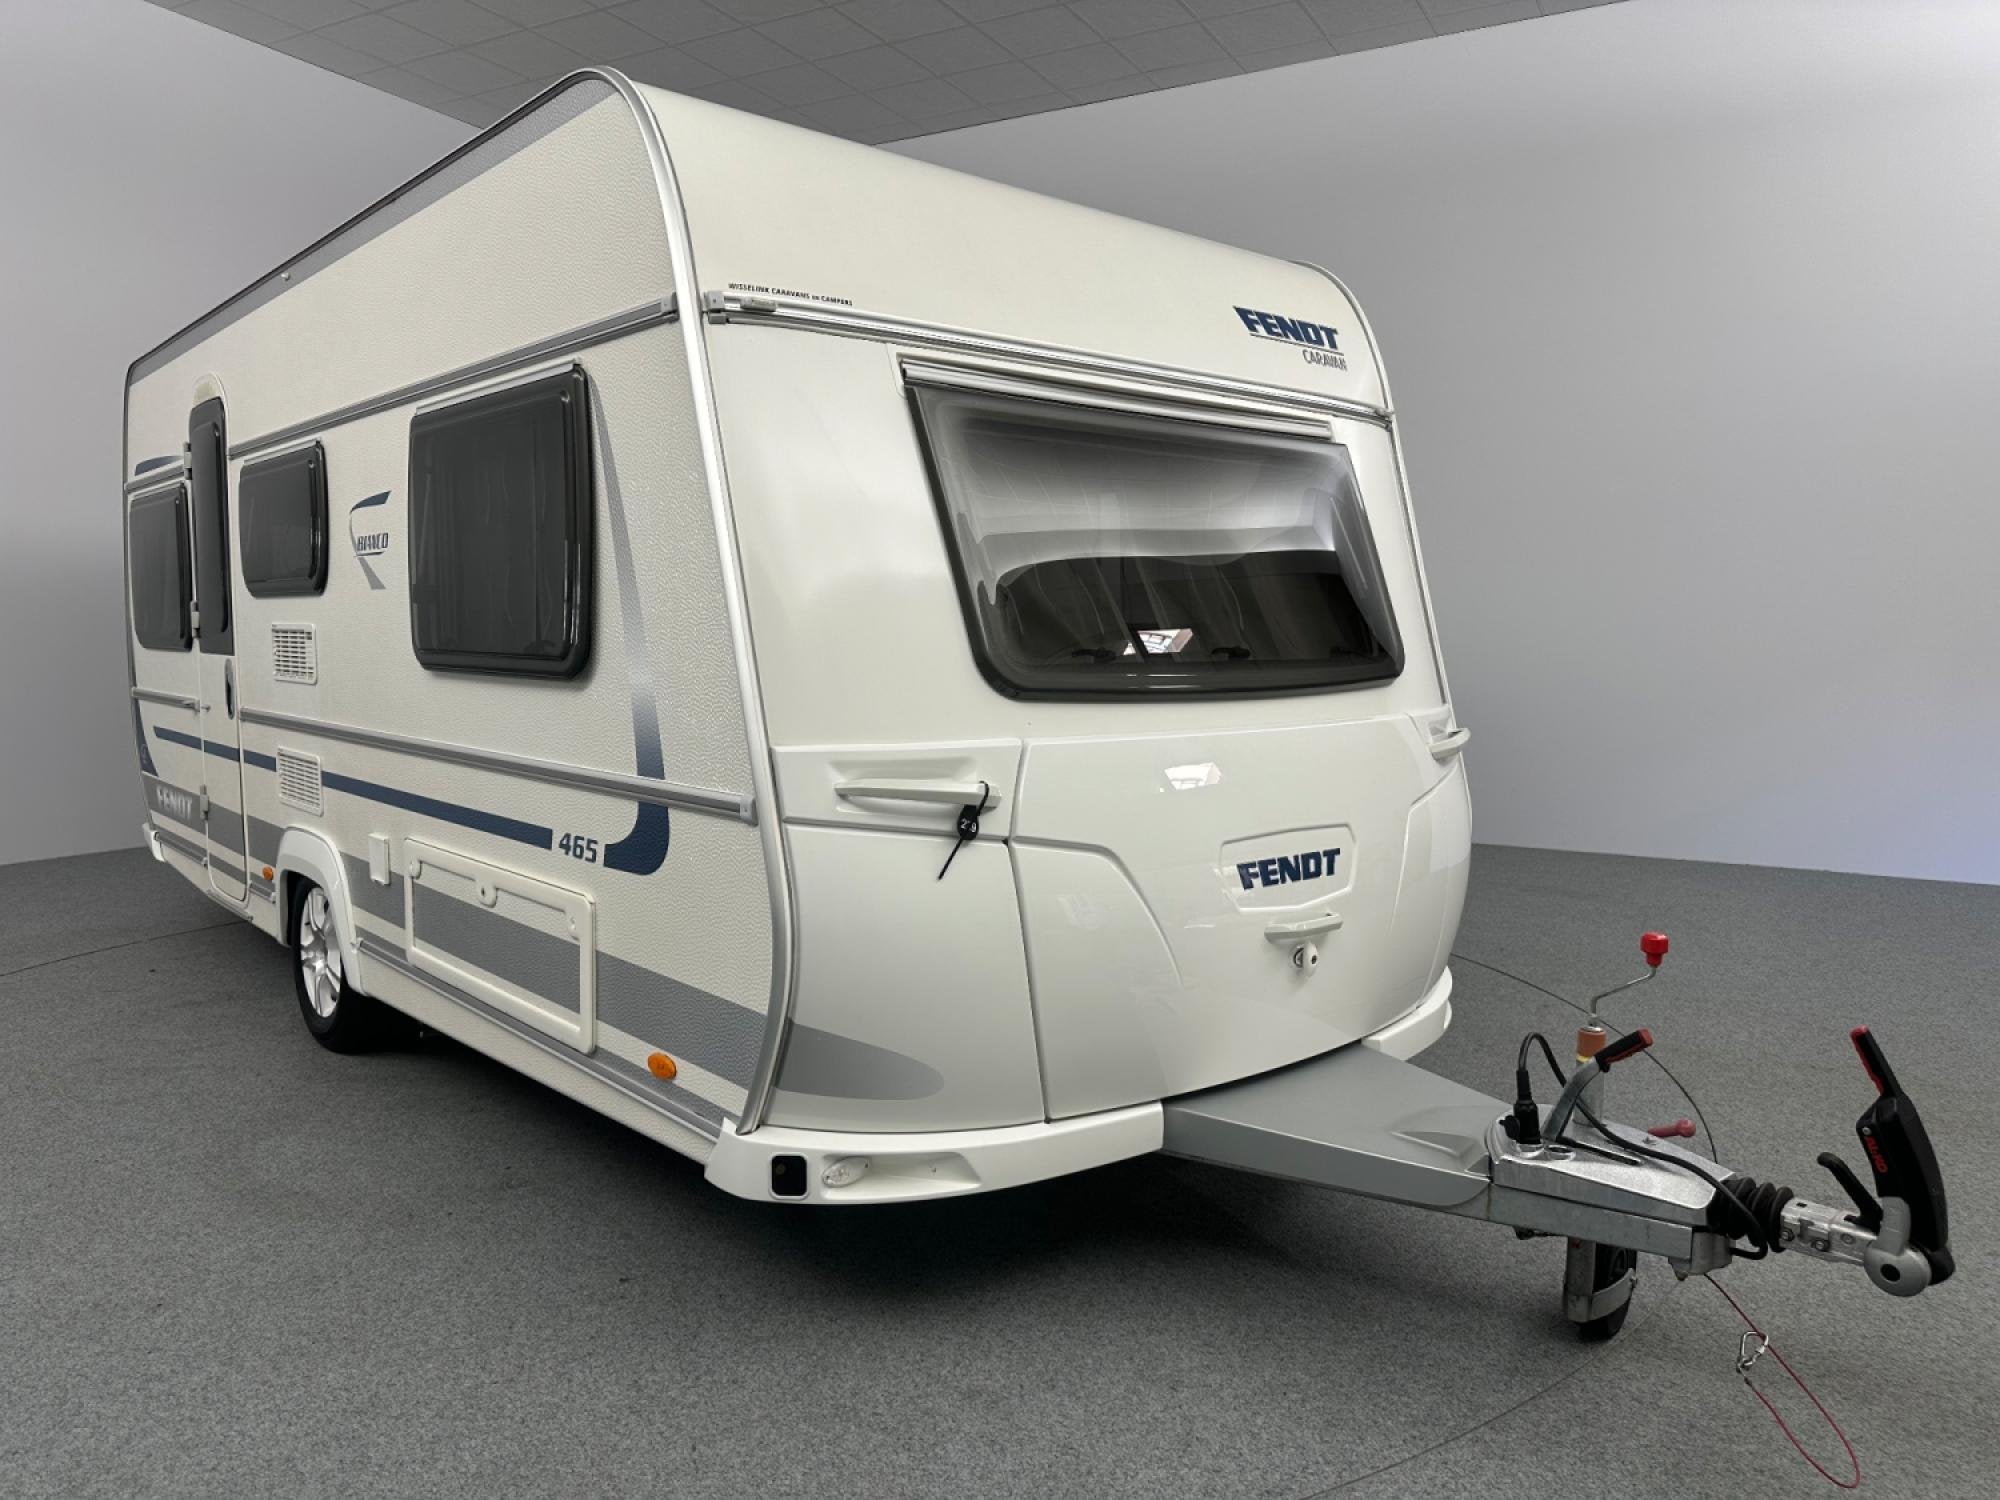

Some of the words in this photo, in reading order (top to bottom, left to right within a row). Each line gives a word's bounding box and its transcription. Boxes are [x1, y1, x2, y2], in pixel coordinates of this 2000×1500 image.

[729, 283, 769, 293] WISSELINK
[771, 288, 810, 299] CARAVANS
[821, 295, 853, 306] CAMPERS
[1233, 306, 1338, 349] FENDT
[1302, 350, 1347, 371] CARAVAN
[357, 532, 389, 551] BIANCO
[156, 785, 192, 820] FENDT
[558, 833, 598, 863] 465
[1236, 848, 1341, 890] FENDT
